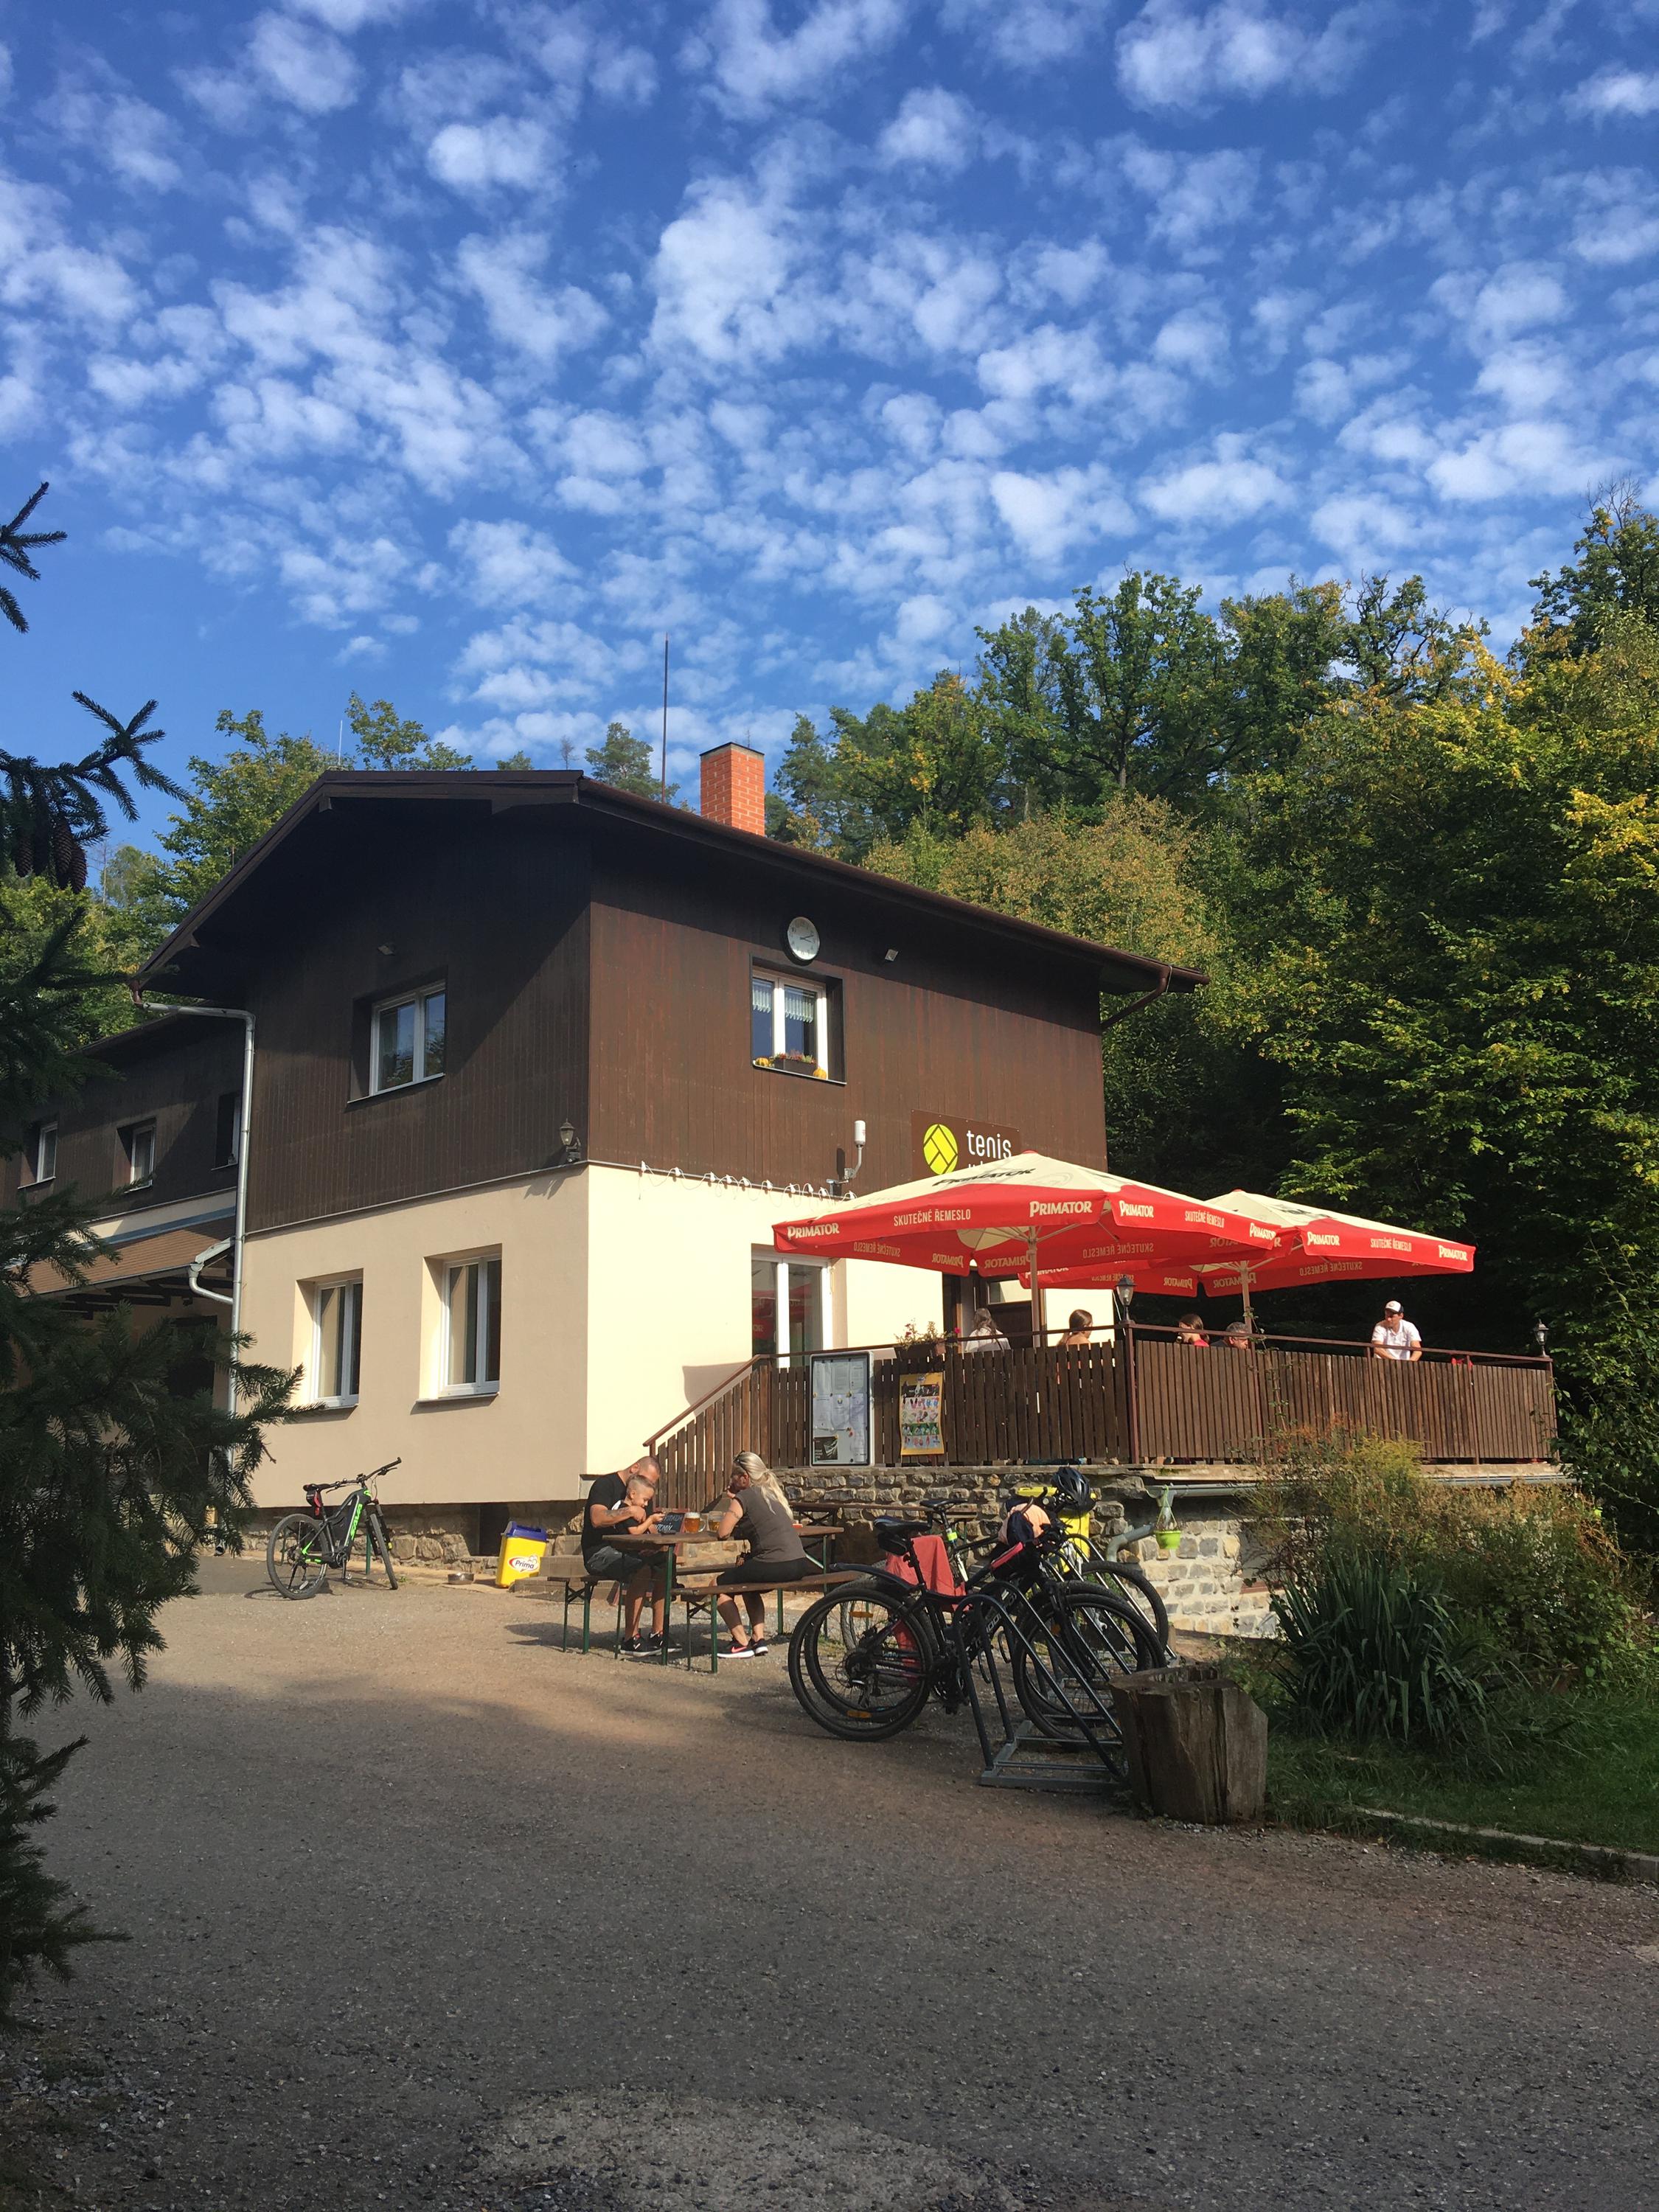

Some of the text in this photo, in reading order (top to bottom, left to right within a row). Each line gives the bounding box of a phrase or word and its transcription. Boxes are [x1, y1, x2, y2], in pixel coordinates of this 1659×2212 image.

[967, 1130, 1013, 1160] tenis
[1029, 1200, 1093, 1217] PRIMATOR
[1119, 1200, 1155, 1218] PRIMATOR
[893, 1208, 971, 1227] SKUTEČNÉ ŘEMESLO
[1185, 1210, 1225, 1228] SKUTEČNÉ ŘEMESLO
[787, 1222, 841, 1240] PRIMATOR
[1307, 1231, 1340, 1246] PRIMATOR
[1370, 1237, 1412, 1252] SKUTEČNÉ ŘEMESLO
[1438, 1245, 1468, 1262] PRIMATOR
[515, 1559, 535, 1570] Prima
